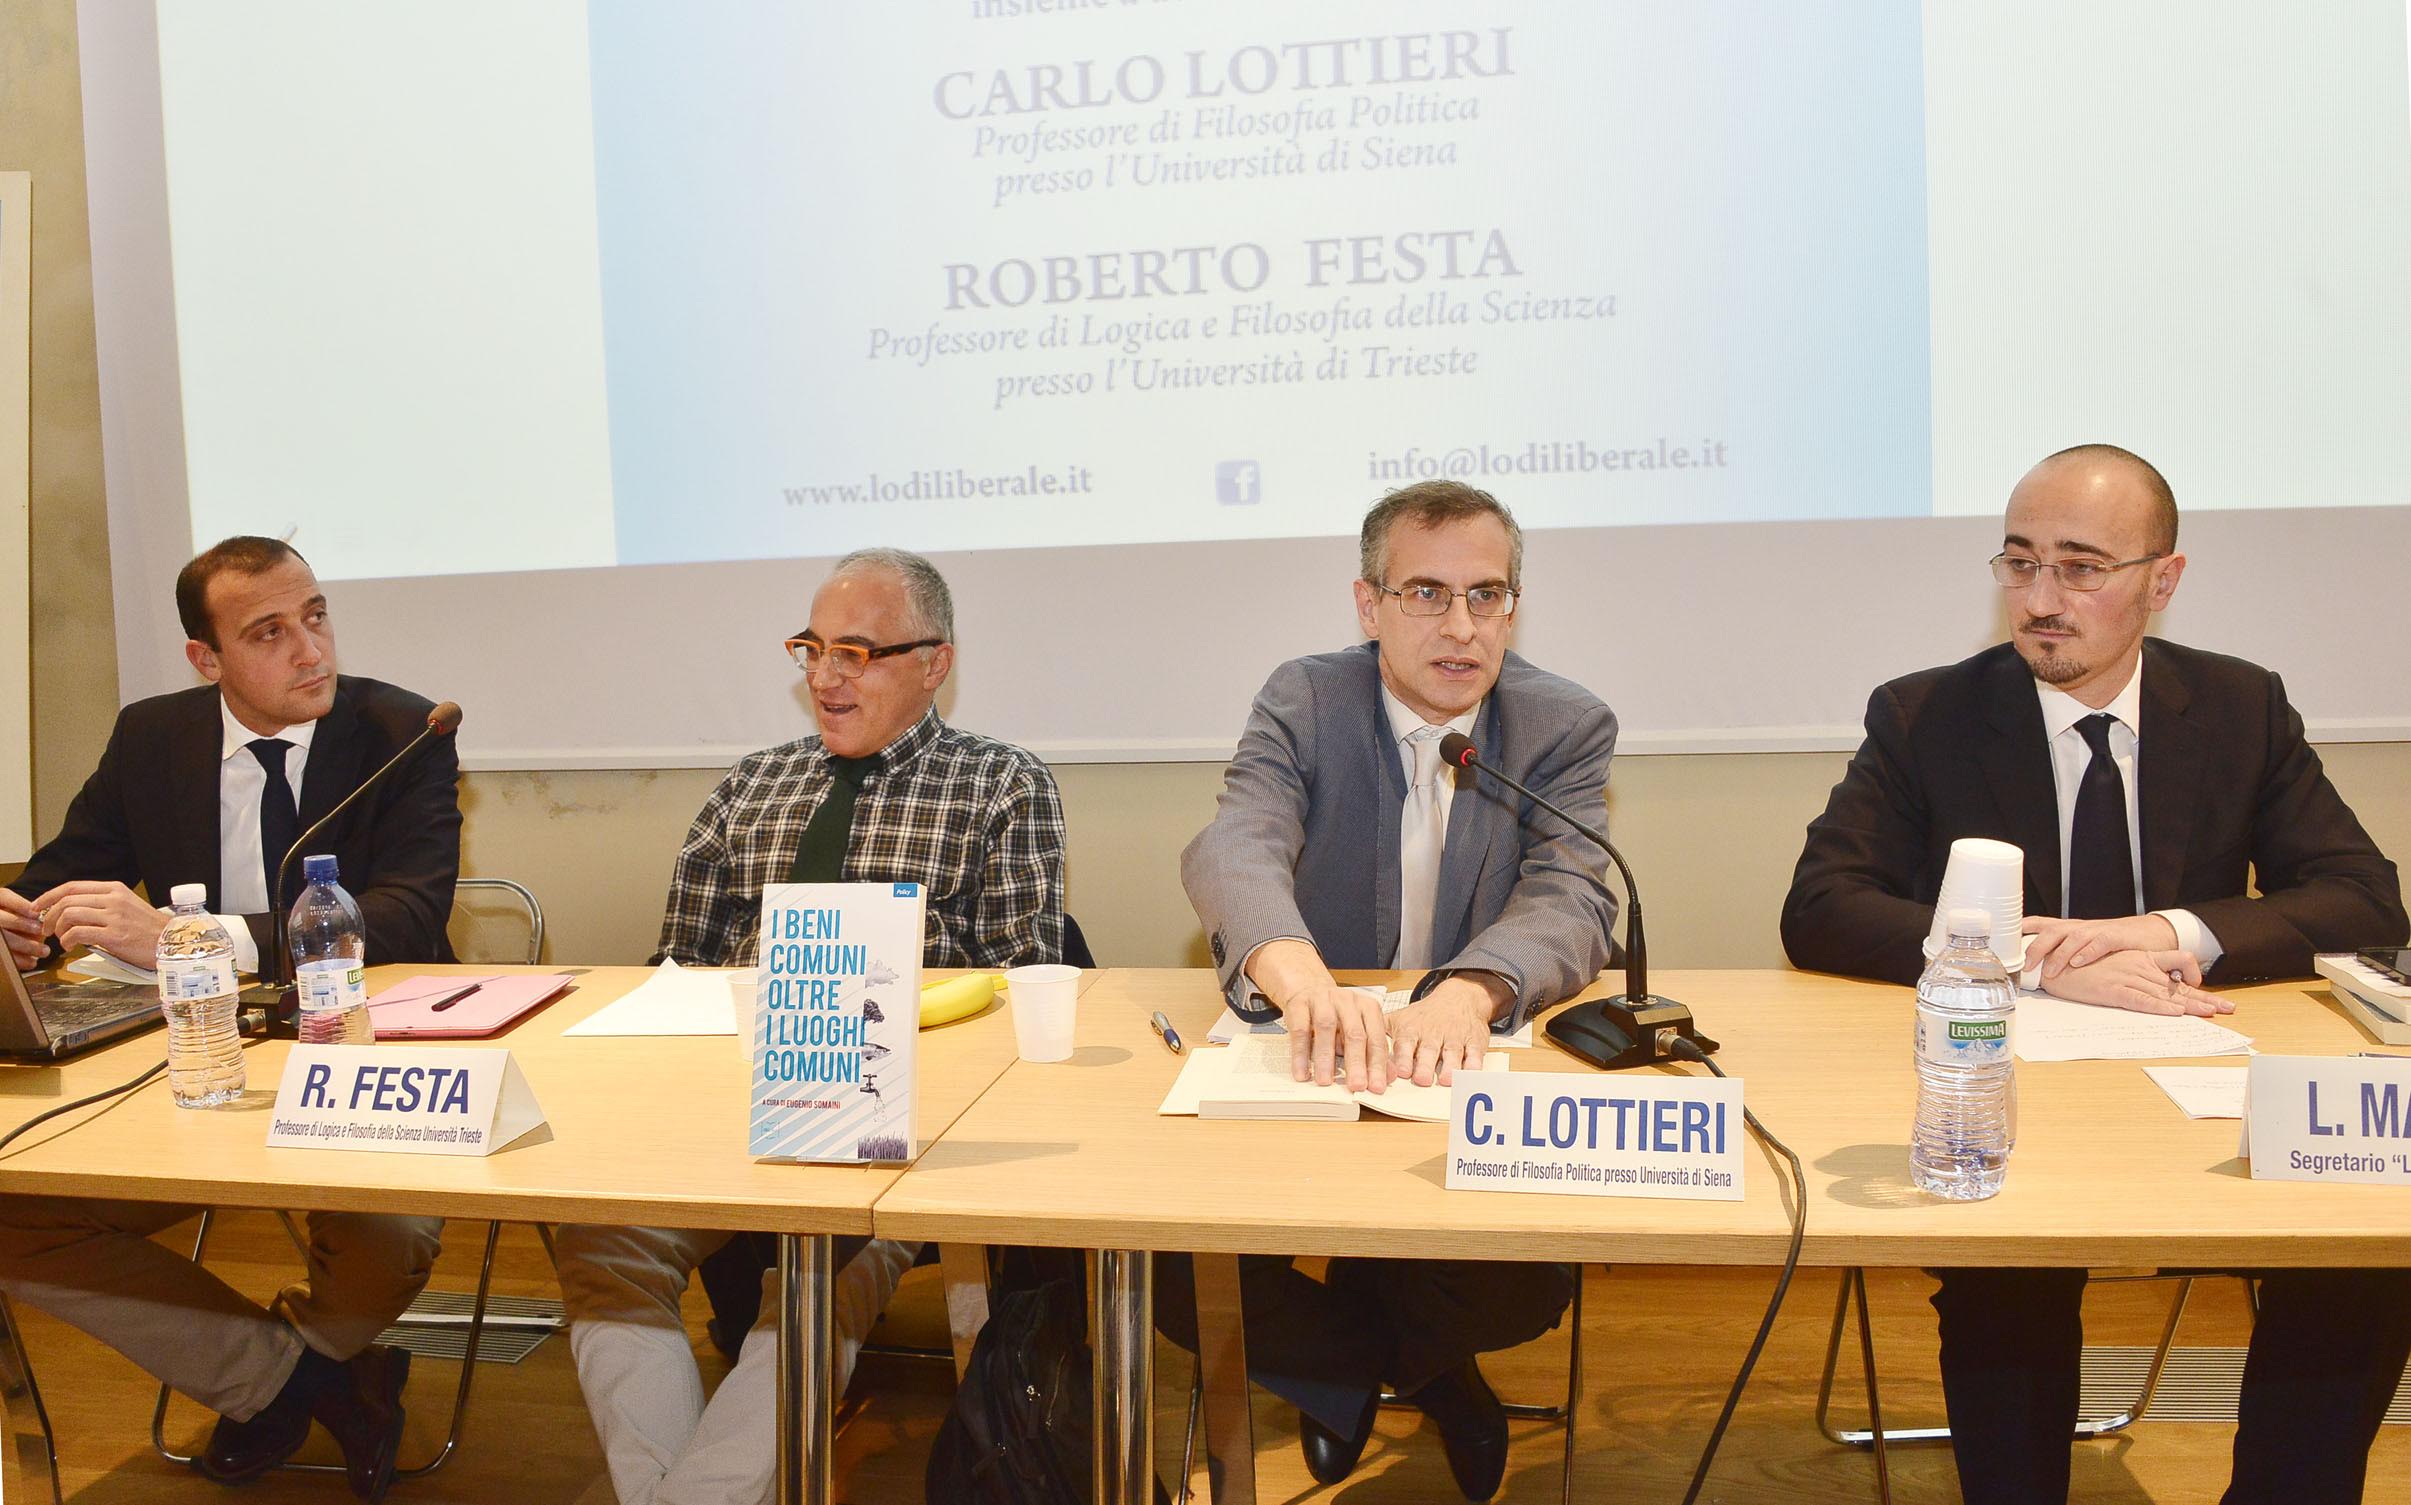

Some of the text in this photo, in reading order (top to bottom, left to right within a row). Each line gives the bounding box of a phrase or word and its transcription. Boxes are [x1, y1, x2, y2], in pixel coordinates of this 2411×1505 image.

[933, 26, 1515, 119] CARLO LOTTIERI
[973, 92, 1480, 163] Professore di Filosofia Politica
[994, 166, 1093, 207] presso
[1317, 136, 1350, 172] di
[1360, 136, 1457, 170] Siena
[942, 228, 1523, 311] ROBERTO FESTA
[866, 289, 1617, 367] Professore di Logica e Filosofia della Scienza
[994, 369, 1093, 410] presso
[1316, 345, 1349, 382] di
[1361, 345, 1479, 378] Trieste
[1368, 438, 1729, 480] info@lodiliberale.it
[781, 465, 1094, 506] www.lodiliberale.it
[772, 909, 841, 940] I BENI
[770, 944, 867, 976] COMUNI
[768, 979, 841, 1011] OLTRE
[765, 1014, 866, 1048] I LUOGHI
[1951, 1022, 2005, 1038] LEVISSIMA
[764, 1050, 861, 1084] COMUNI
[300, 1064, 470, 1114] R. FESTA
[786, 1100, 813, 1109] EUGENIO
[814, 1100, 841, 1110] SOMAINI
[2308, 1081, 2344, 1136] L.
[274, 1119, 310, 1136] Professore
[310, 1121, 319, 1136] di
[318, 1121, 341, 1141] Logica
[341, 1126, 347, 1138] e
[347, 1122, 376, 1139] Filosofia
[377, 1124, 394, 1140] della
[395, 1124, 422, 1141] Scienza
[459, 1127, 482, 1143] Trieste
[1465, 1092, 1726, 1154] C. LOTTIERI
[1456, 1158, 1731, 1187] Professore di Filosofia Politica presso Università di Siena
[2290, 1150, 2385, 1174] Segretario
